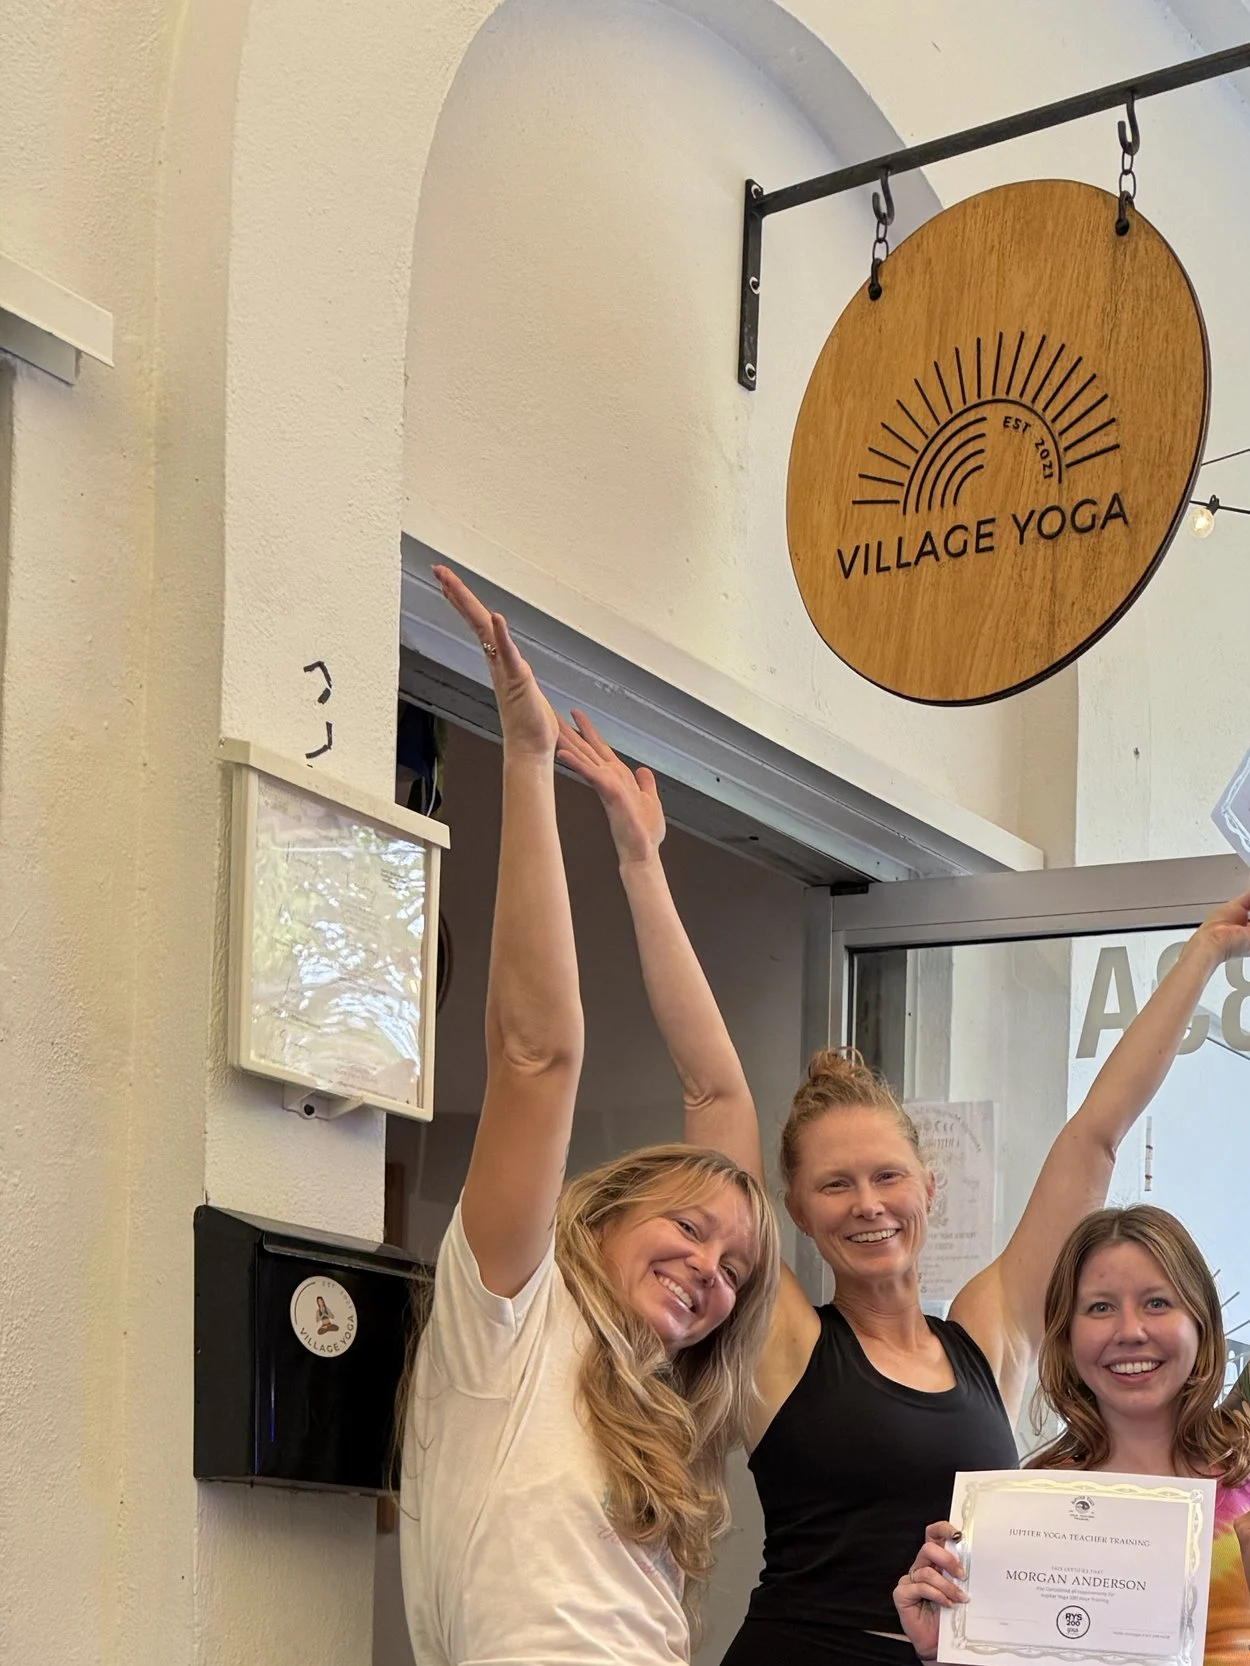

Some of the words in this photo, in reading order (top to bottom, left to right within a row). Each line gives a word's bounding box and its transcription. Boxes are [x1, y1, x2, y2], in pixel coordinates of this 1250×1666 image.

[1003, 416, 1031, 434] EST
[1035, 437, 1053, 479] 2021
[837, 518, 996, 579] VILLAGE
[1011, 493, 1129, 545] YOGA
[300, 1327, 340, 1353] VILLAGE
[340, 1314, 355, 1345] YOGA
[1043, 1532, 1067, 1540] YOGA
[1069, 1534, 1107, 1543] TEACHER
[1109, 1537, 1150, 1547] TRAINING
[1006, 1570, 1067, 1584] MORGAN
[1071, 1576, 1146, 1590] ANDERSON
[1066, 1613, 1082, 1621] RYS
